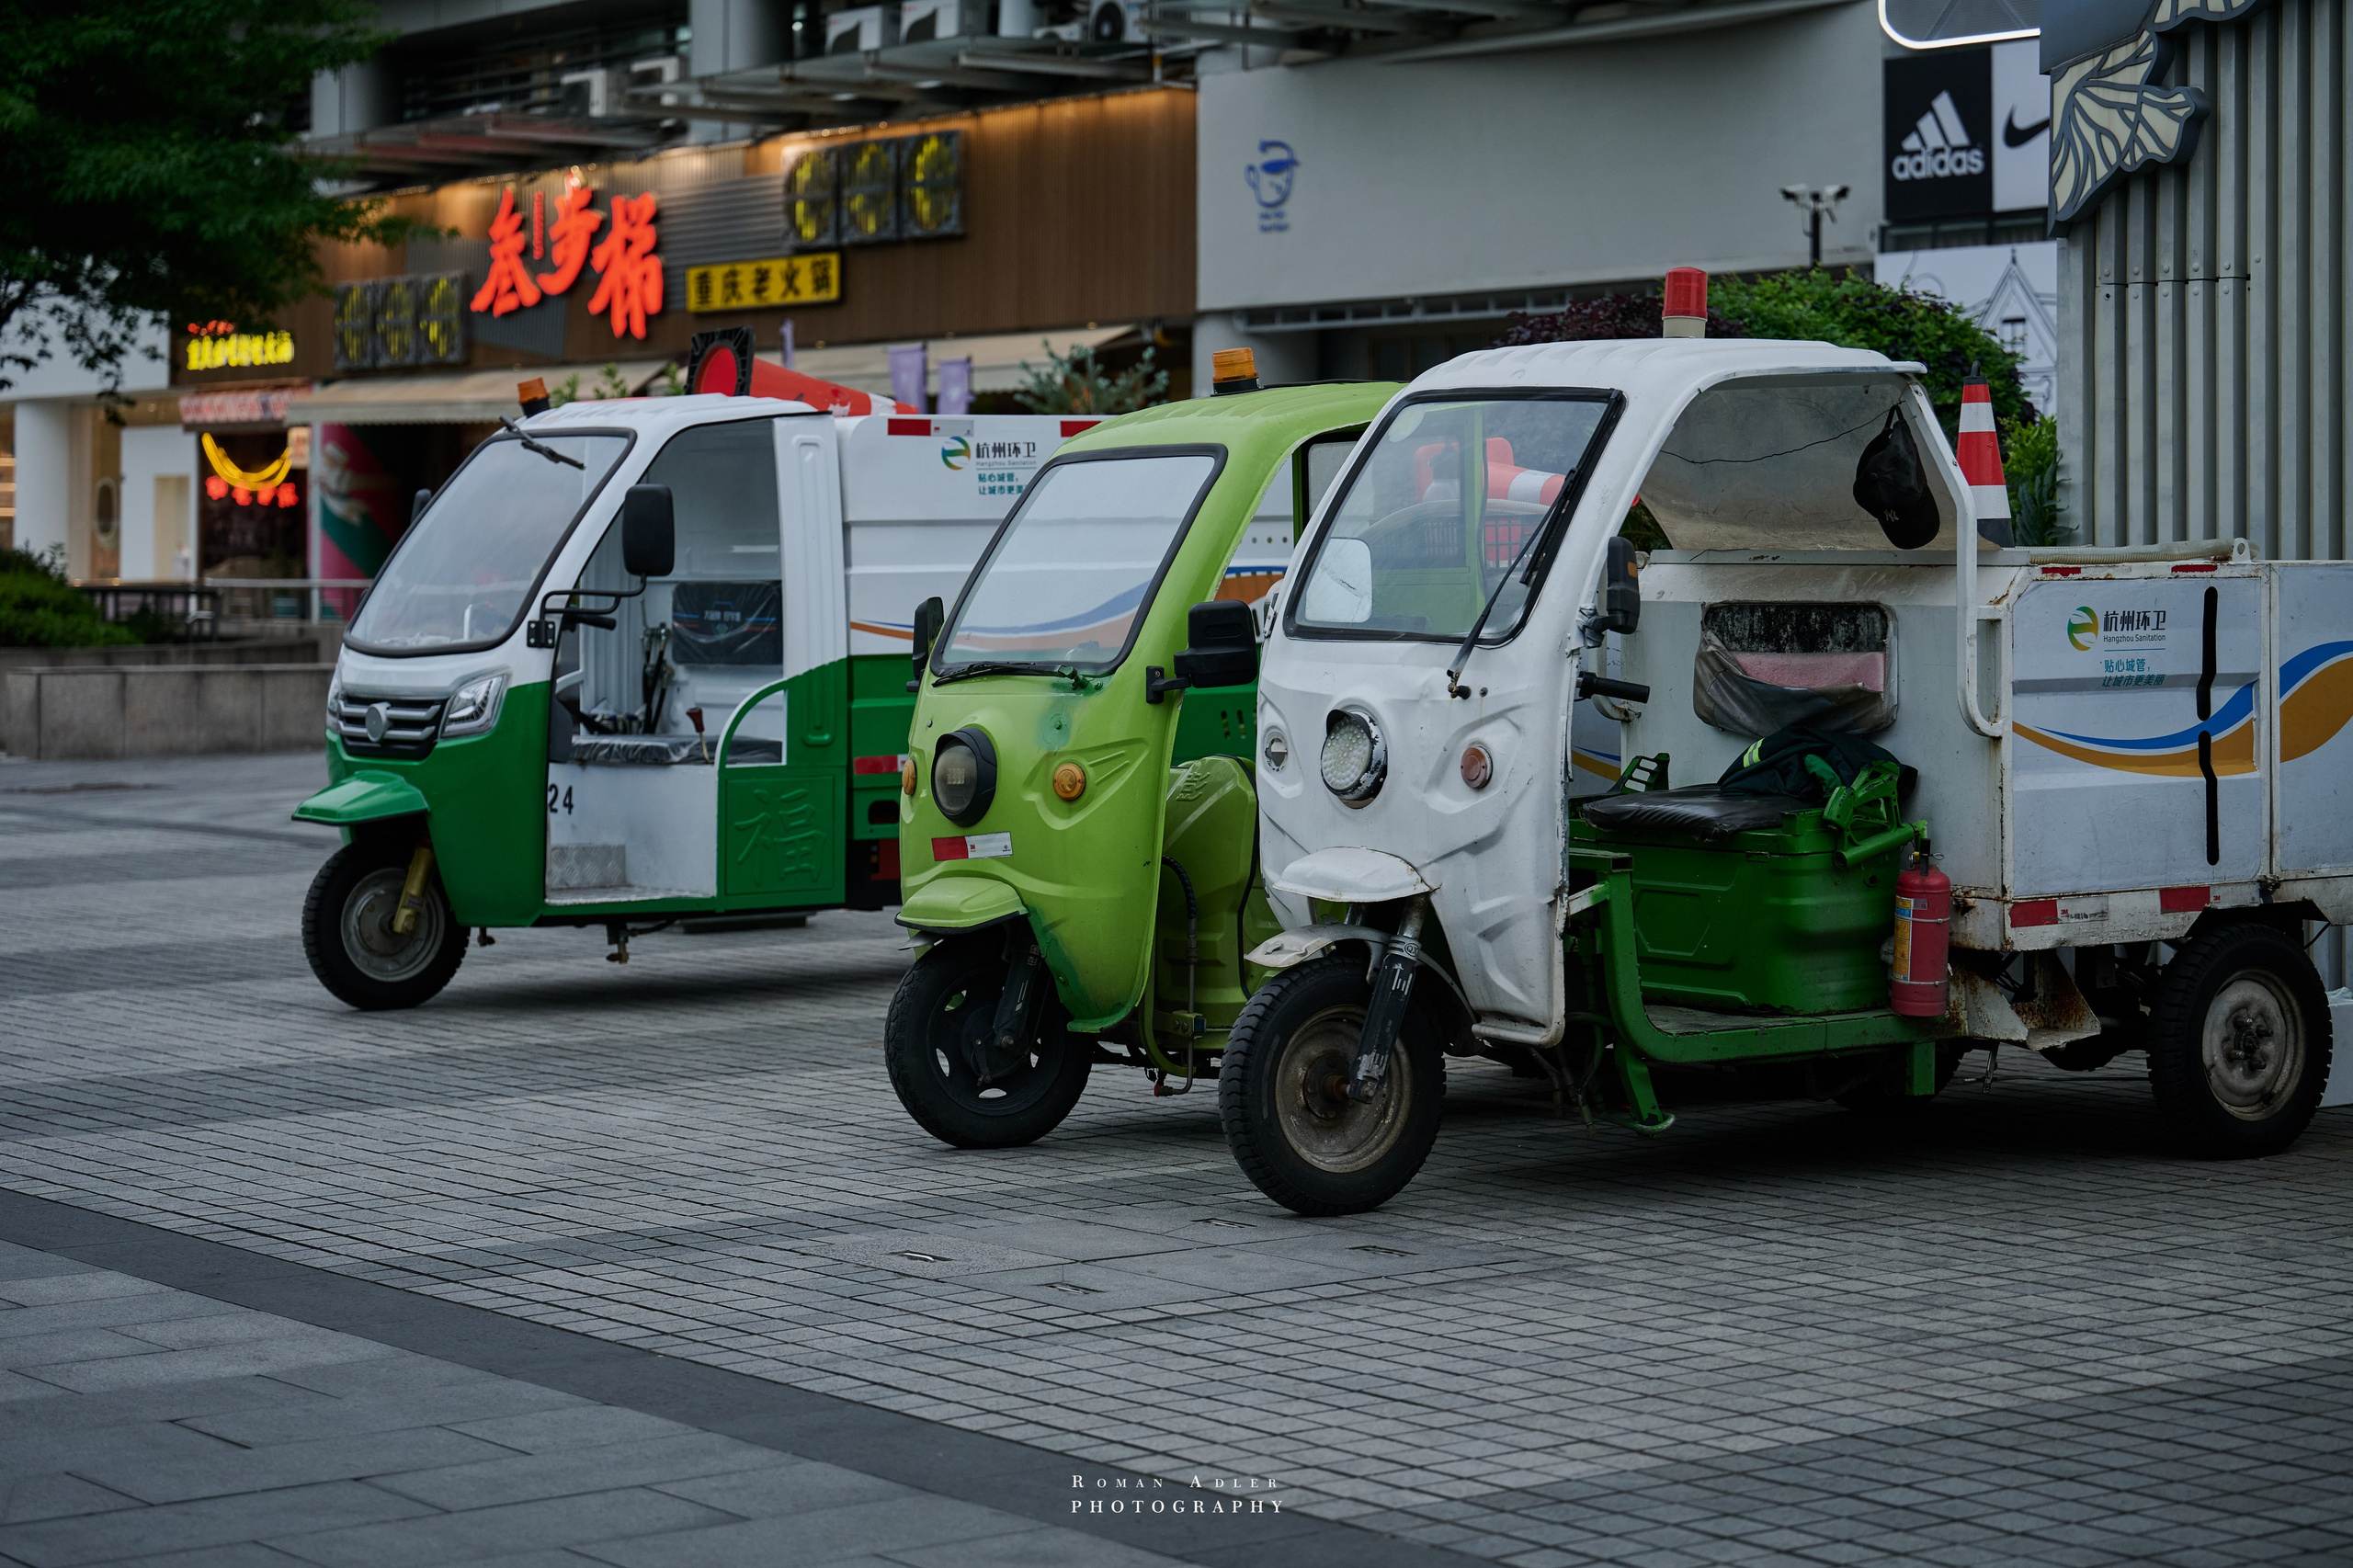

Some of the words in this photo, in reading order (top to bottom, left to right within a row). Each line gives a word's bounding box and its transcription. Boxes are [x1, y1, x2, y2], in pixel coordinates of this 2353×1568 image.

[1892, 147, 1985, 181] adidas
[695, 258, 831, 305] 重庆老火锅
[976, 442, 1036, 459] 杭州环卫
[979, 485, 1026, 494] 让城市更美
[2103, 610, 2166, 631] 杭州环卫
[2104, 634, 2133, 643] Hangzhou
[2102, 674, 2165, 687] 让城市更美丽
[549, 783, 574, 815] 24
[735, 789, 826, 886] 福
